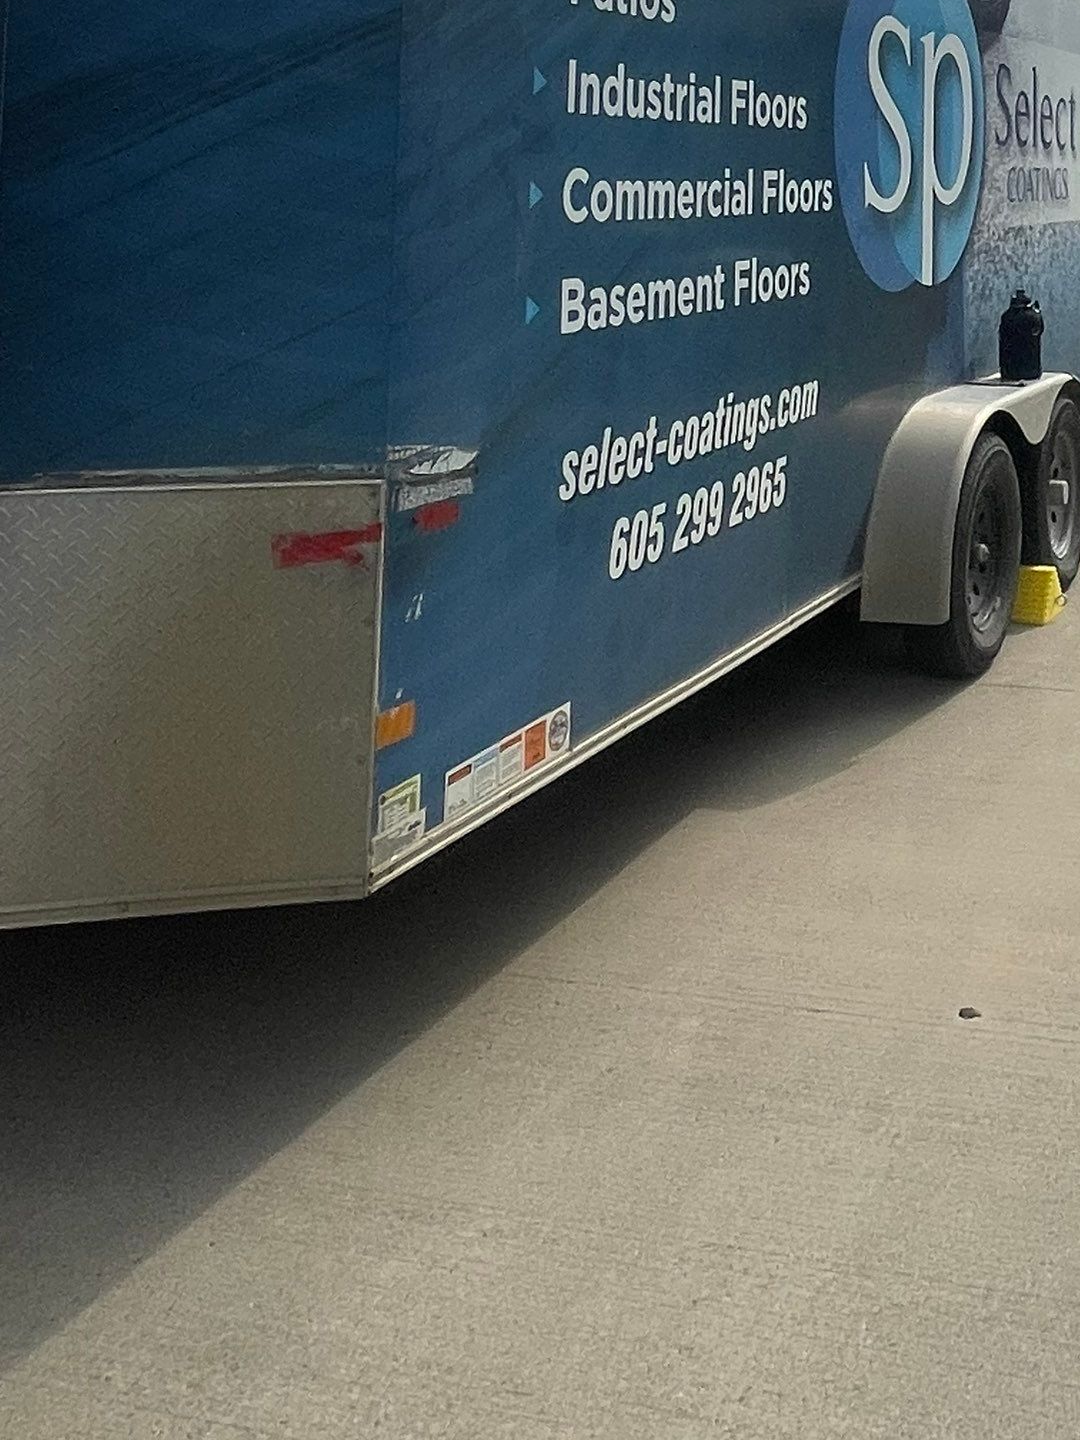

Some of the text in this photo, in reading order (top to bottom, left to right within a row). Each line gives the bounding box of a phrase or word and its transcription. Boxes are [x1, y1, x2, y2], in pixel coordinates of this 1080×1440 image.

[566, 58, 809, 130] Industrial Floors
[995, 62, 1078, 155] Select
[562, 166, 834, 224] Commercial Floors
[1005, 166, 1070, 204] COATINGS
[559, 257, 811, 336] Basement Floors
[558, 377, 821, 502] select-coatings.com
[607, 454, 789, 581] 605 299 2965
